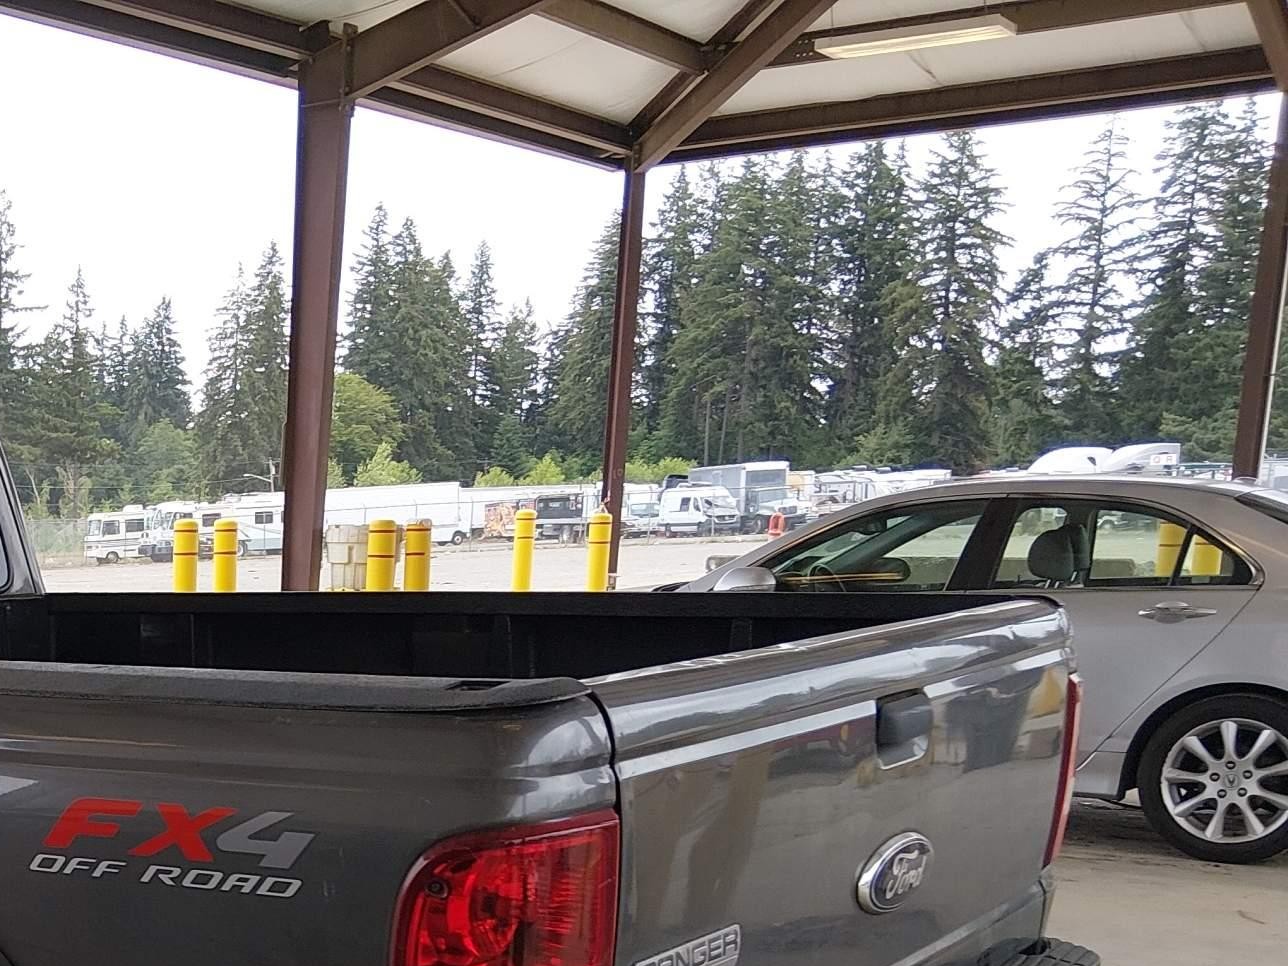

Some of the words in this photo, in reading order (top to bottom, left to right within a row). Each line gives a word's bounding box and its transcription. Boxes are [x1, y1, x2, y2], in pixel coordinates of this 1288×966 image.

[41, 796, 316, 870] FX4
[28, 853, 128, 878] OFF
[139, 864, 304, 898] ROAD
[886, 850, 927, 899] Ford
